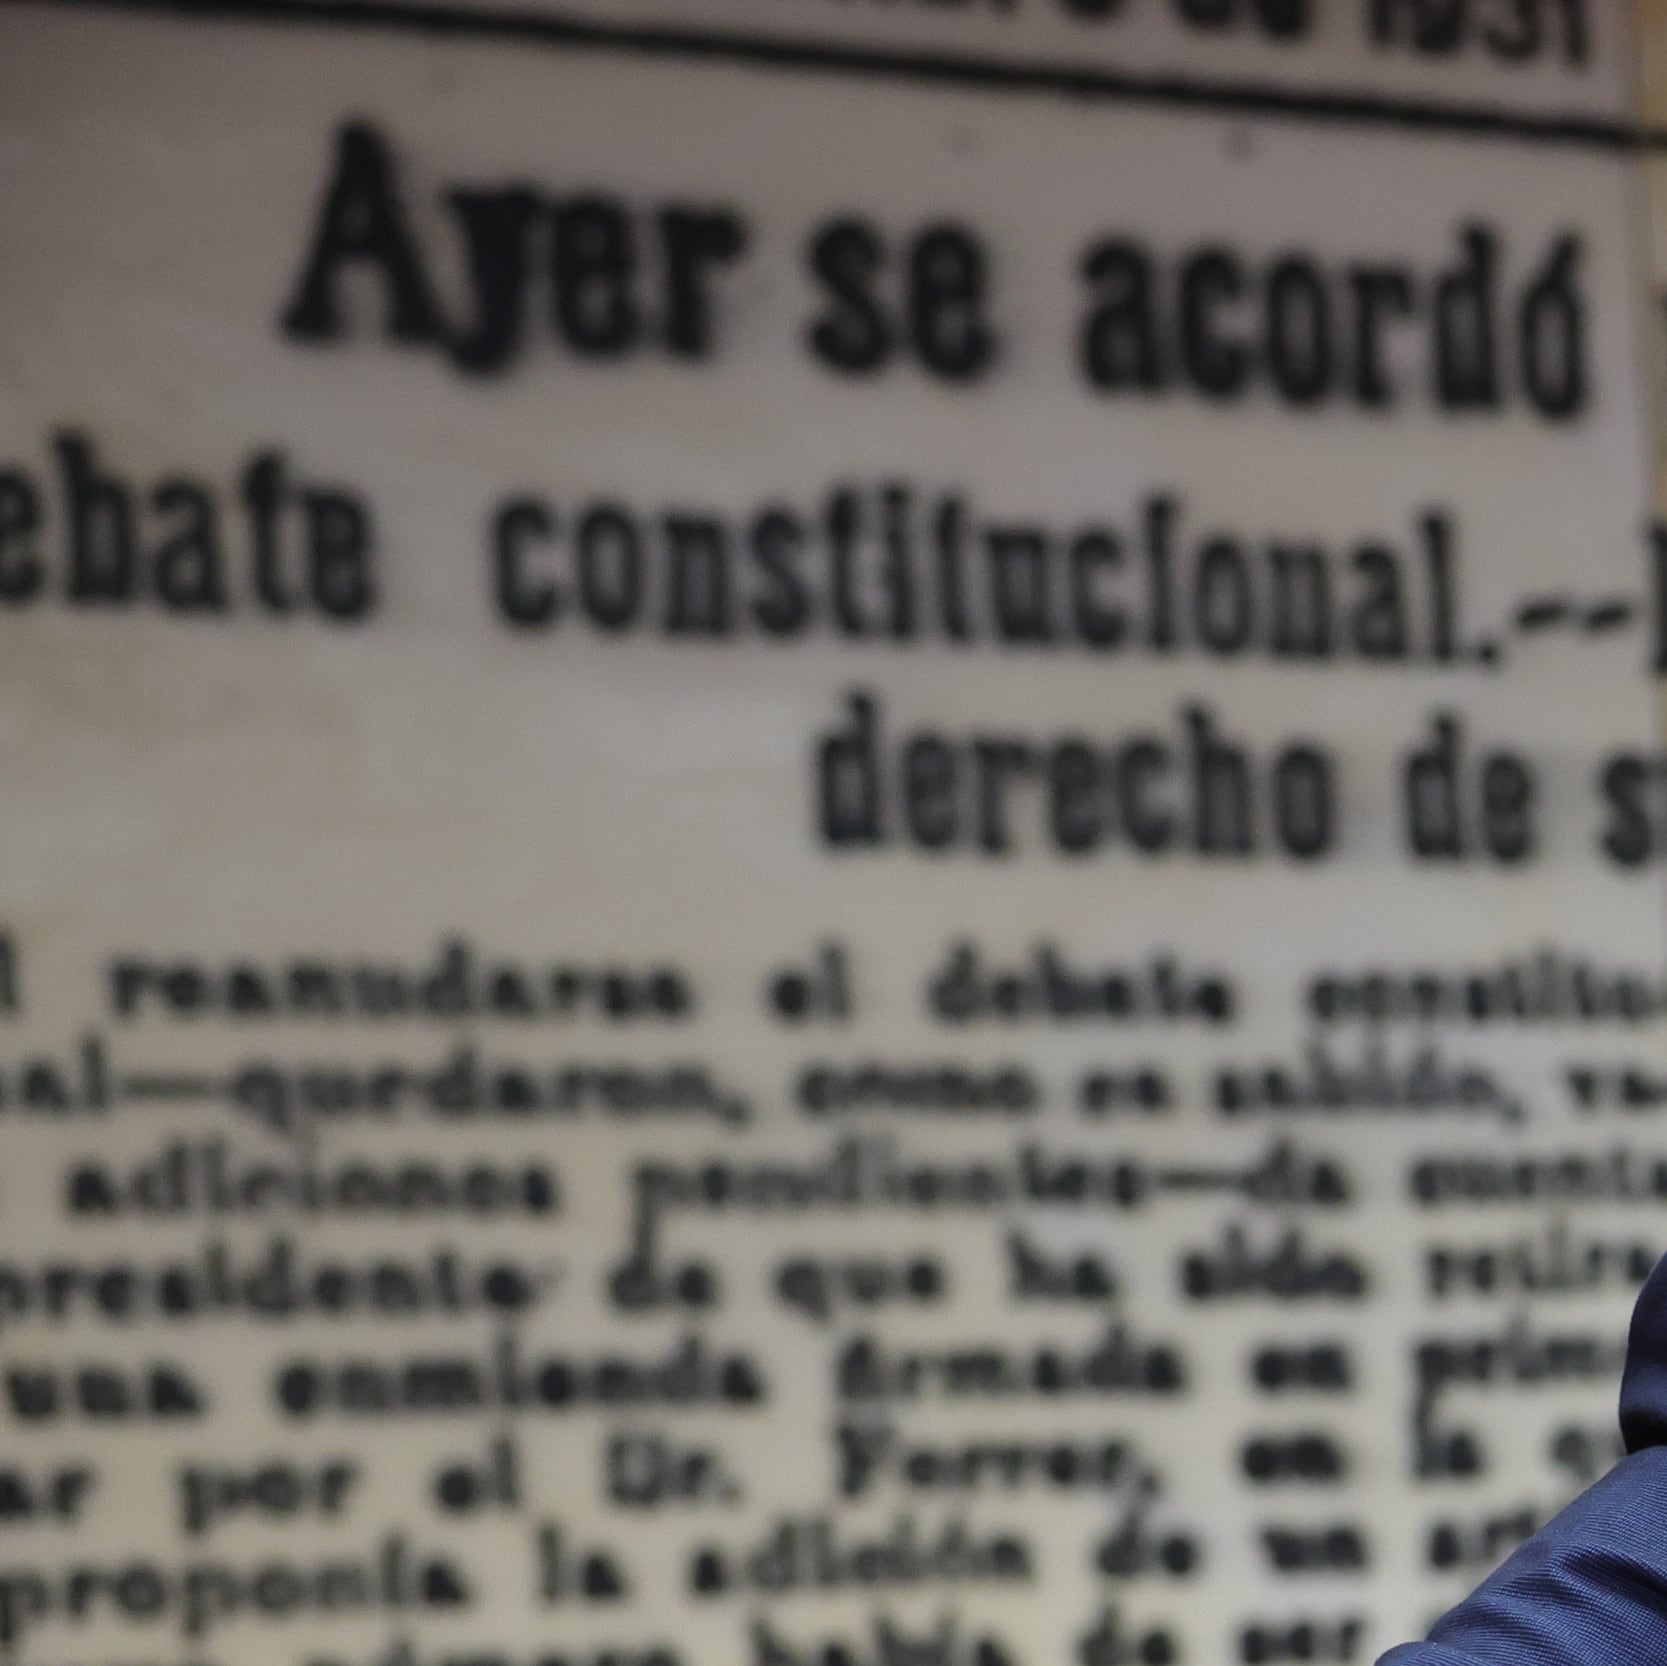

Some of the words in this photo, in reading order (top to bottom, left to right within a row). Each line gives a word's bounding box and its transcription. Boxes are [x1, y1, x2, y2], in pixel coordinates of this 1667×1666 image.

[281, 116, 746, 380] Ayer
[807, 210, 996, 384] se
[1080, 224, 1592, 425] acordó
[0, 426, 378, 626] ebate
[815, 690, 1334, 862] derecho
[1406, 714, 1536, 864] de
[108, 934, 694, 1022] reanudarse
[766, 940, 852, 1023] el
[930, 943, 1235, 1023] debate
[66, 1136, 560, 1219] adiciones
[606, 1232, 717, 1318] de
[774, 1256, 944, 1326] que
[5, 1360, 206, 1426] una
[270, 1330, 768, 1422] enmienda
[0, 1460, 95, 1527] ar
[175, 1458, 358, 1542] por
[430, 1430, 522, 1518] el
[0, 1530, 472, 1645] proponía
[536, 1518, 632, 1609] la
